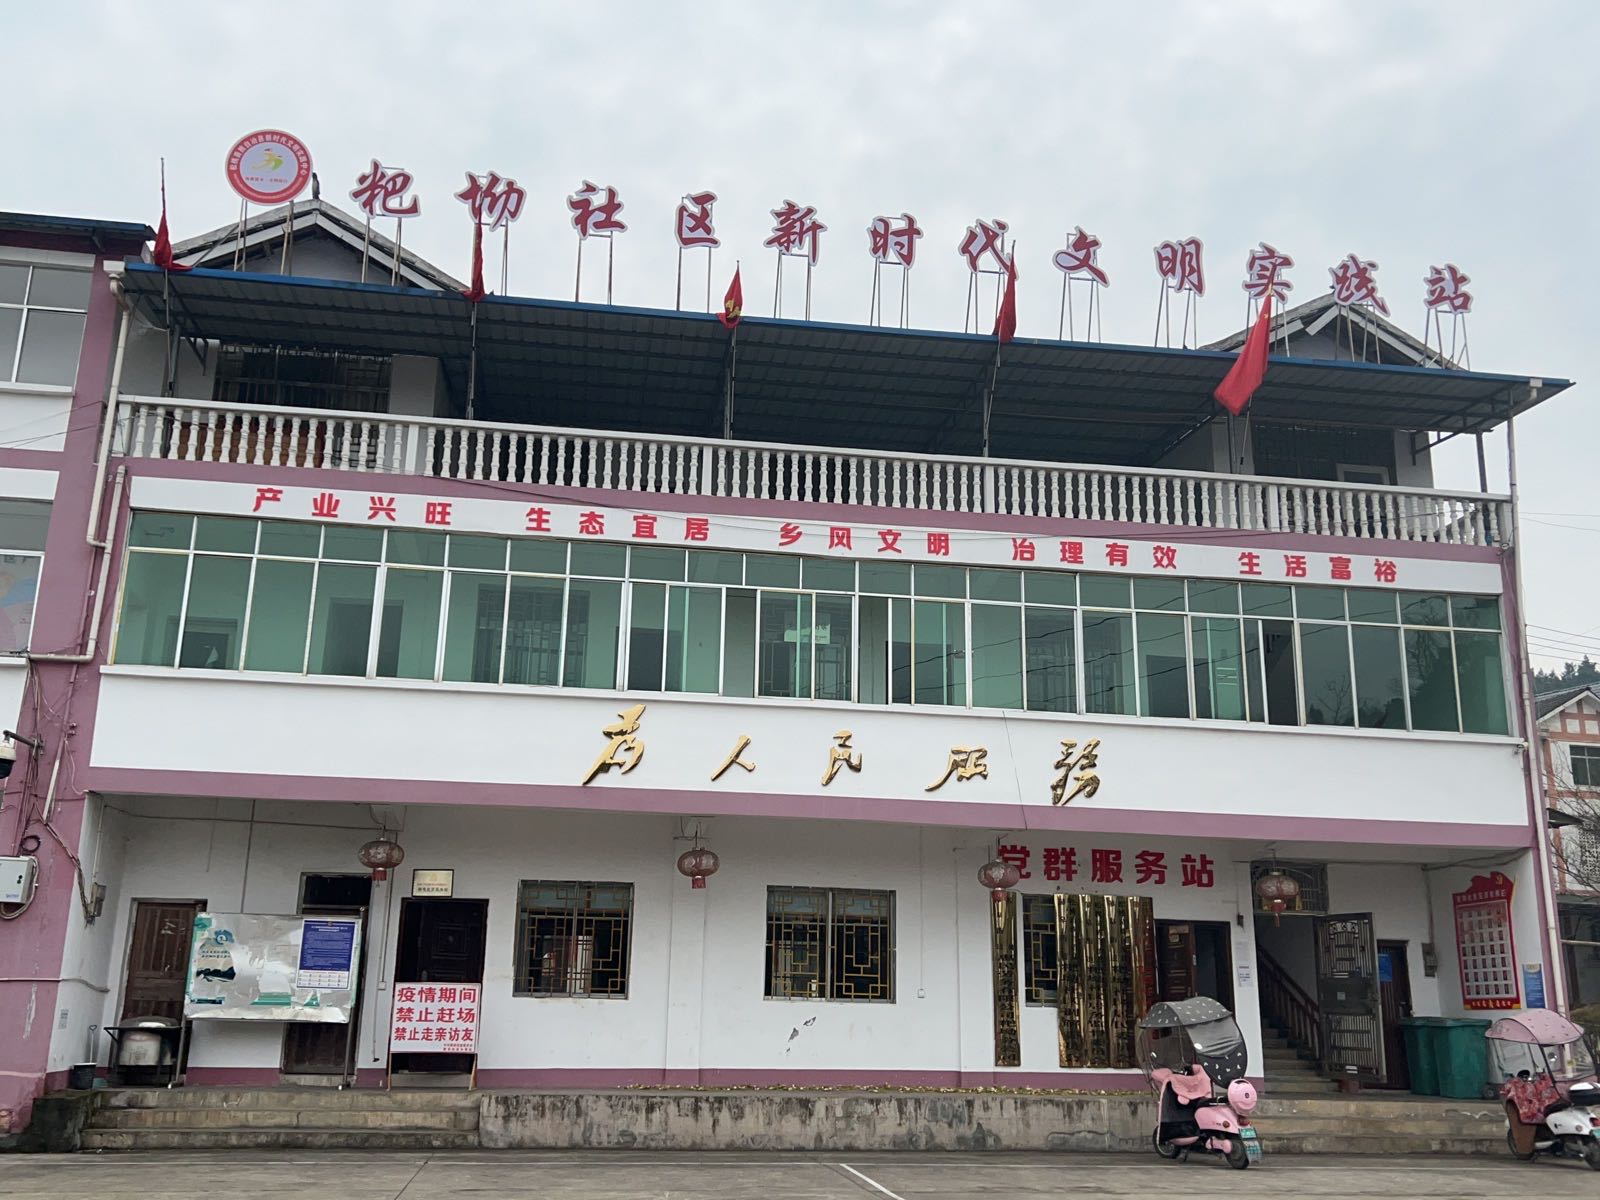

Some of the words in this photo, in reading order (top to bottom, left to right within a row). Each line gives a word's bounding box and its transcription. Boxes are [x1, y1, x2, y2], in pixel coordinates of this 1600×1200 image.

[350, 158, 1473, 317] 粑坳社区新时代文明实践站
[252, 487, 452, 526] 产业兴旺
[525, 507, 709, 541] 生态宜居
[779, 522, 950, 557] 乡风文明
[1012, 538, 1177, 570] 治理有效
[1238, 552, 1397, 583] 生活富裕
[998, 844, 1214, 888] 党群服务站
[397, 987, 477, 1004] 疫情期间
[396, 1007, 476, 1023] 禁止赶场
[394, 1027, 474, 1042] 禁止走亲访友
